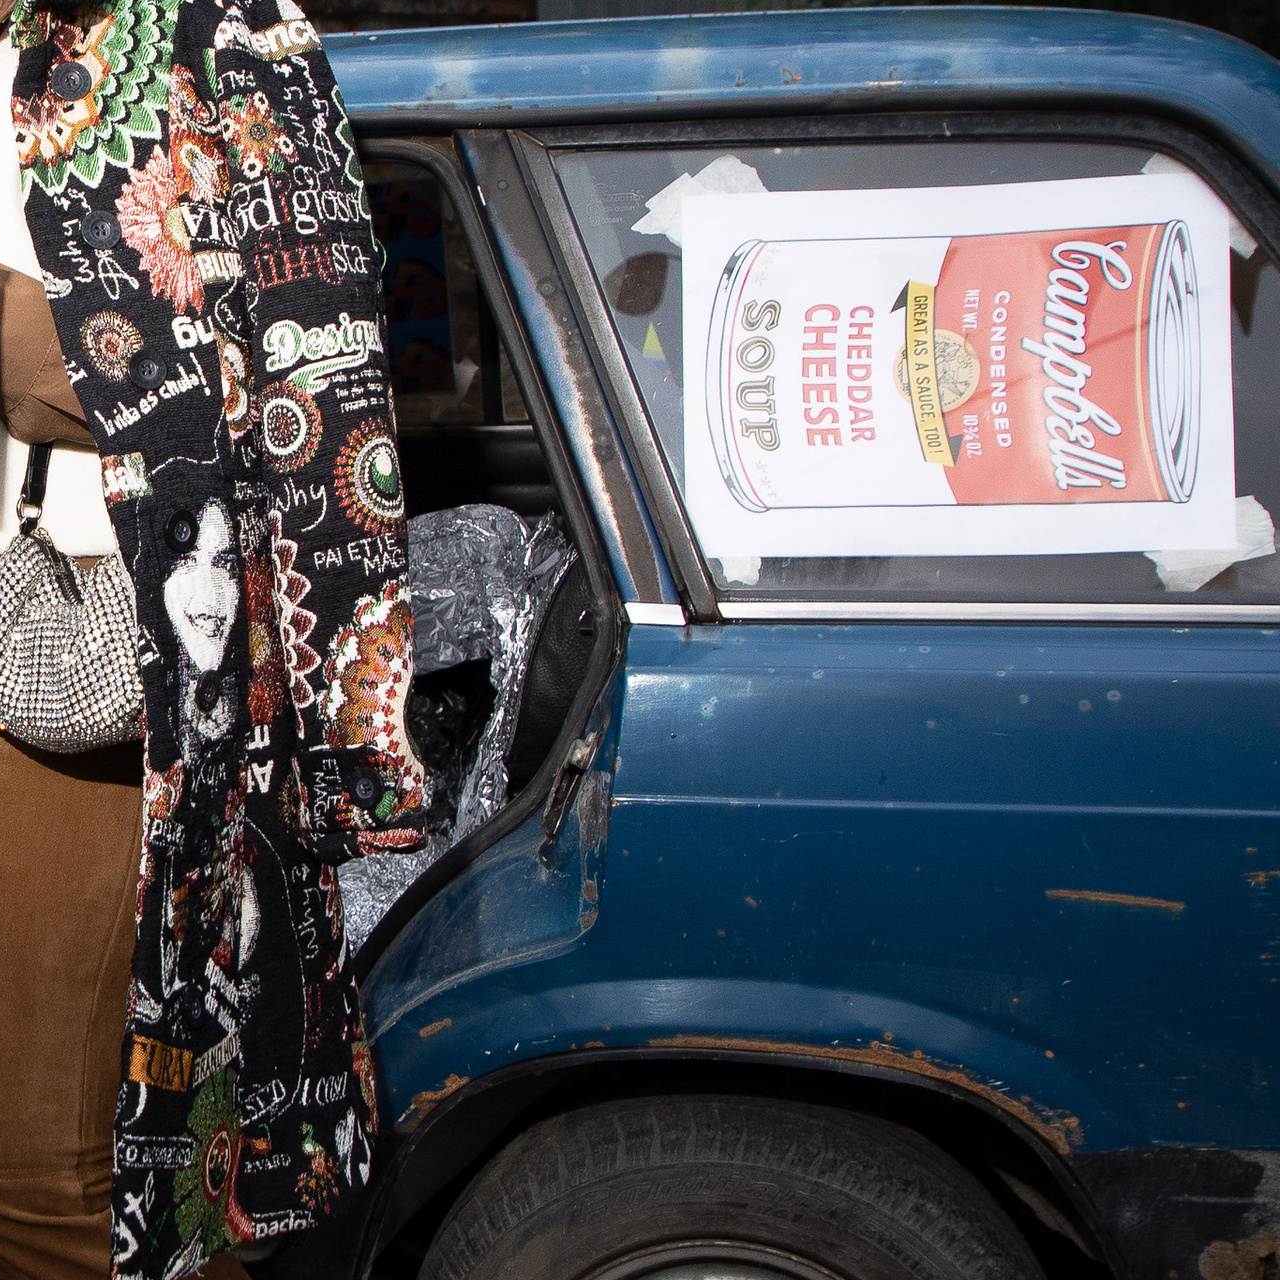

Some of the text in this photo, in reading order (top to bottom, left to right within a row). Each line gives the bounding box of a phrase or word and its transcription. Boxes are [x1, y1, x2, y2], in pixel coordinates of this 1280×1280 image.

[913, 295, 929, 335] GREAT
[962, 288, 981, 332] NET WT.
[914, 339, 929, 356] AS
[914, 362, 930, 372] A
[989, 289, 1013, 449] CONDENSED
[735, 298, 782, 452] SOUP
[801, 303, 843, 447] CHEESE
[846, 305, 877, 443] CHEDDAR
[916, 376, 937, 423] SAUCE,
